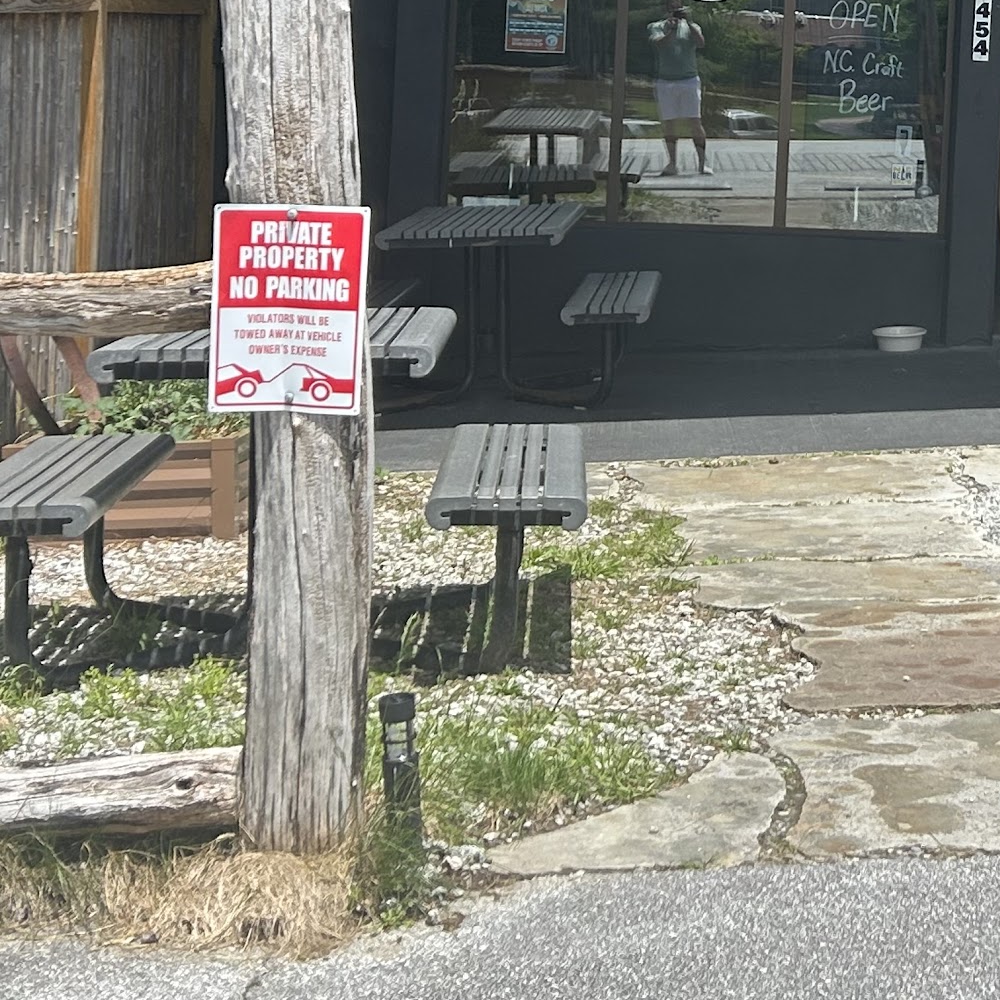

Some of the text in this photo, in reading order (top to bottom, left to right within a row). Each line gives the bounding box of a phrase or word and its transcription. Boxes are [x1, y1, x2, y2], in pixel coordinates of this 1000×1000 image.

[829, 0, 900, 33] OPEN
[973, 2, 991, 56] 454
[862, 52, 905, 78] Craft
[838, 79, 894, 114] Beer
[251, 220, 333, 246] PRIVATE
[238, 246, 345, 271] PROPERTY
[229, 275, 350, 302] NO PARKING
[247, 313, 329, 326] VIOLATORS WILL BE
[234, 329, 342, 342] TOWED AWAY AT VEHICLE
[248, 344, 328, 357] OWNER'S EXPENSE
